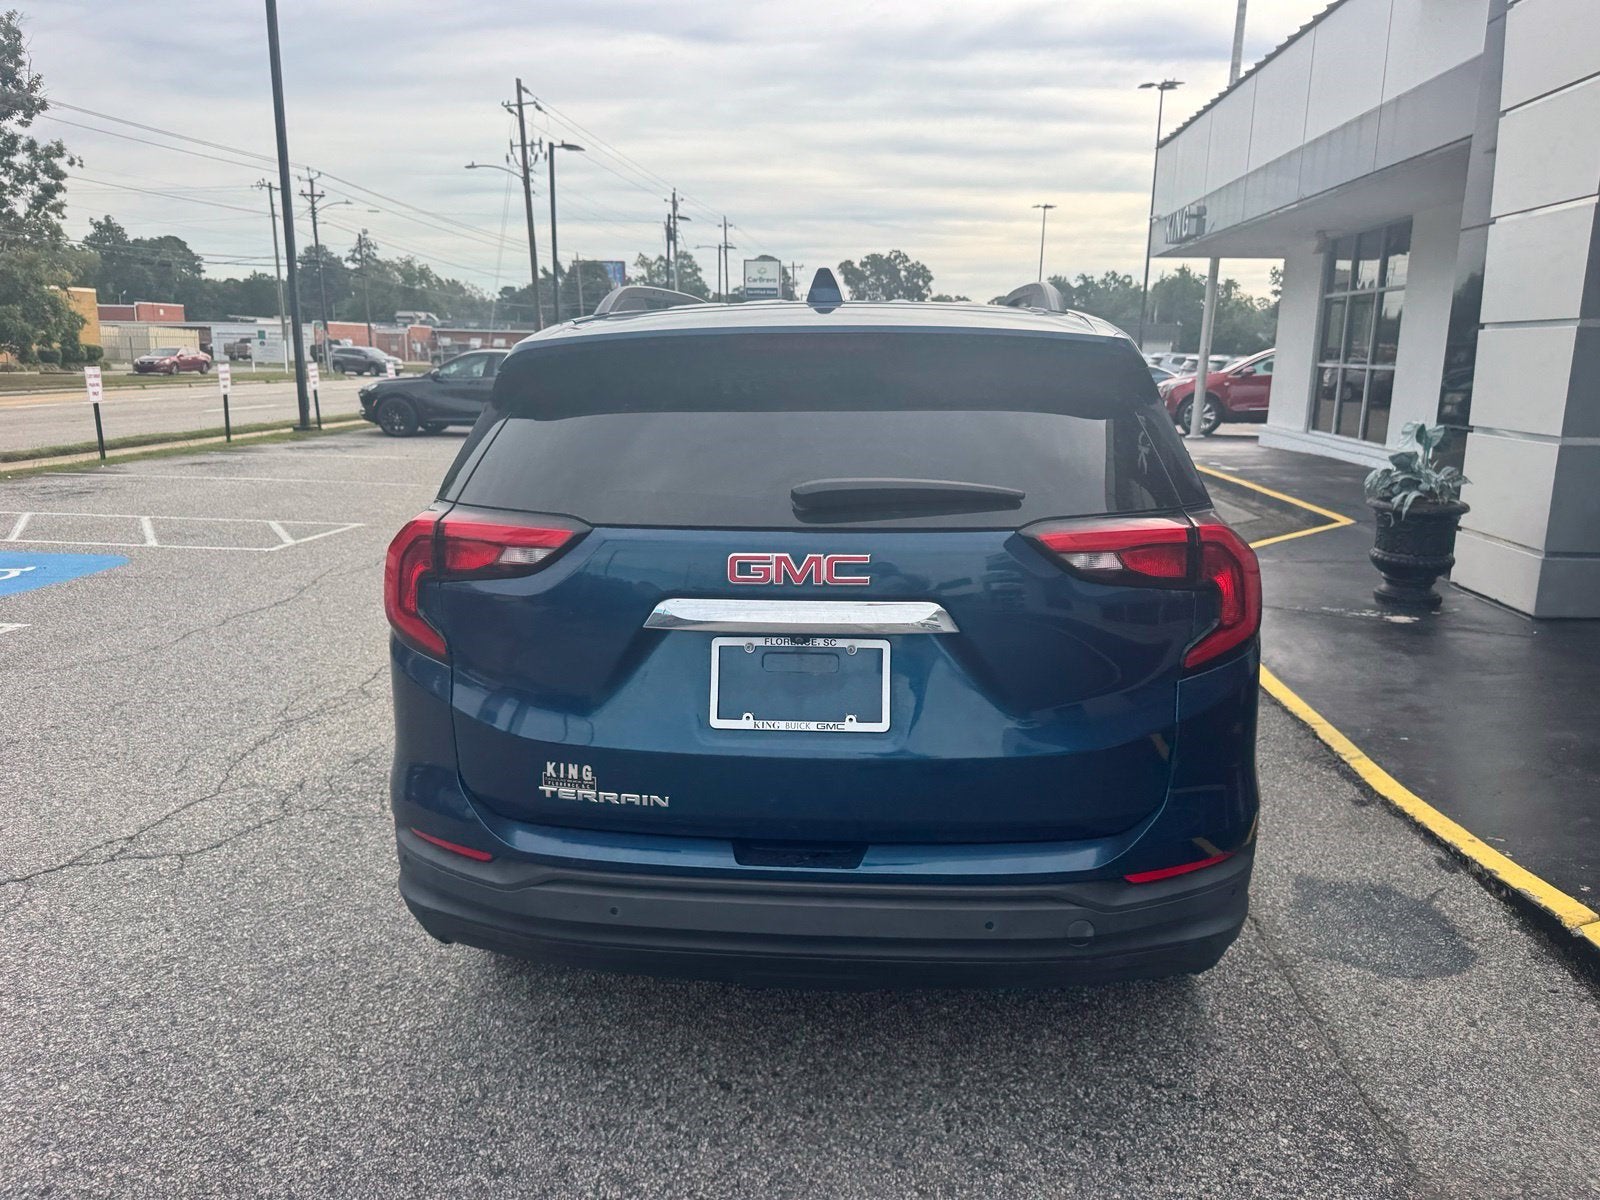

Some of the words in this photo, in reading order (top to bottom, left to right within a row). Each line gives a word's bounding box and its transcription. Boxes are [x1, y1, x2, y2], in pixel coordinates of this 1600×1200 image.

[727, 552, 871, 585] GMC
[764, 637, 820, 646] FLORE,
[823, 638, 837, 646] SC
[753, 720, 780, 729] KING
[785, 721, 811, 730] BUICK
[816, 722, 845, 730] GMC
[546, 761, 593, 781] KING
[538, 786, 669, 808] TERRAIN
